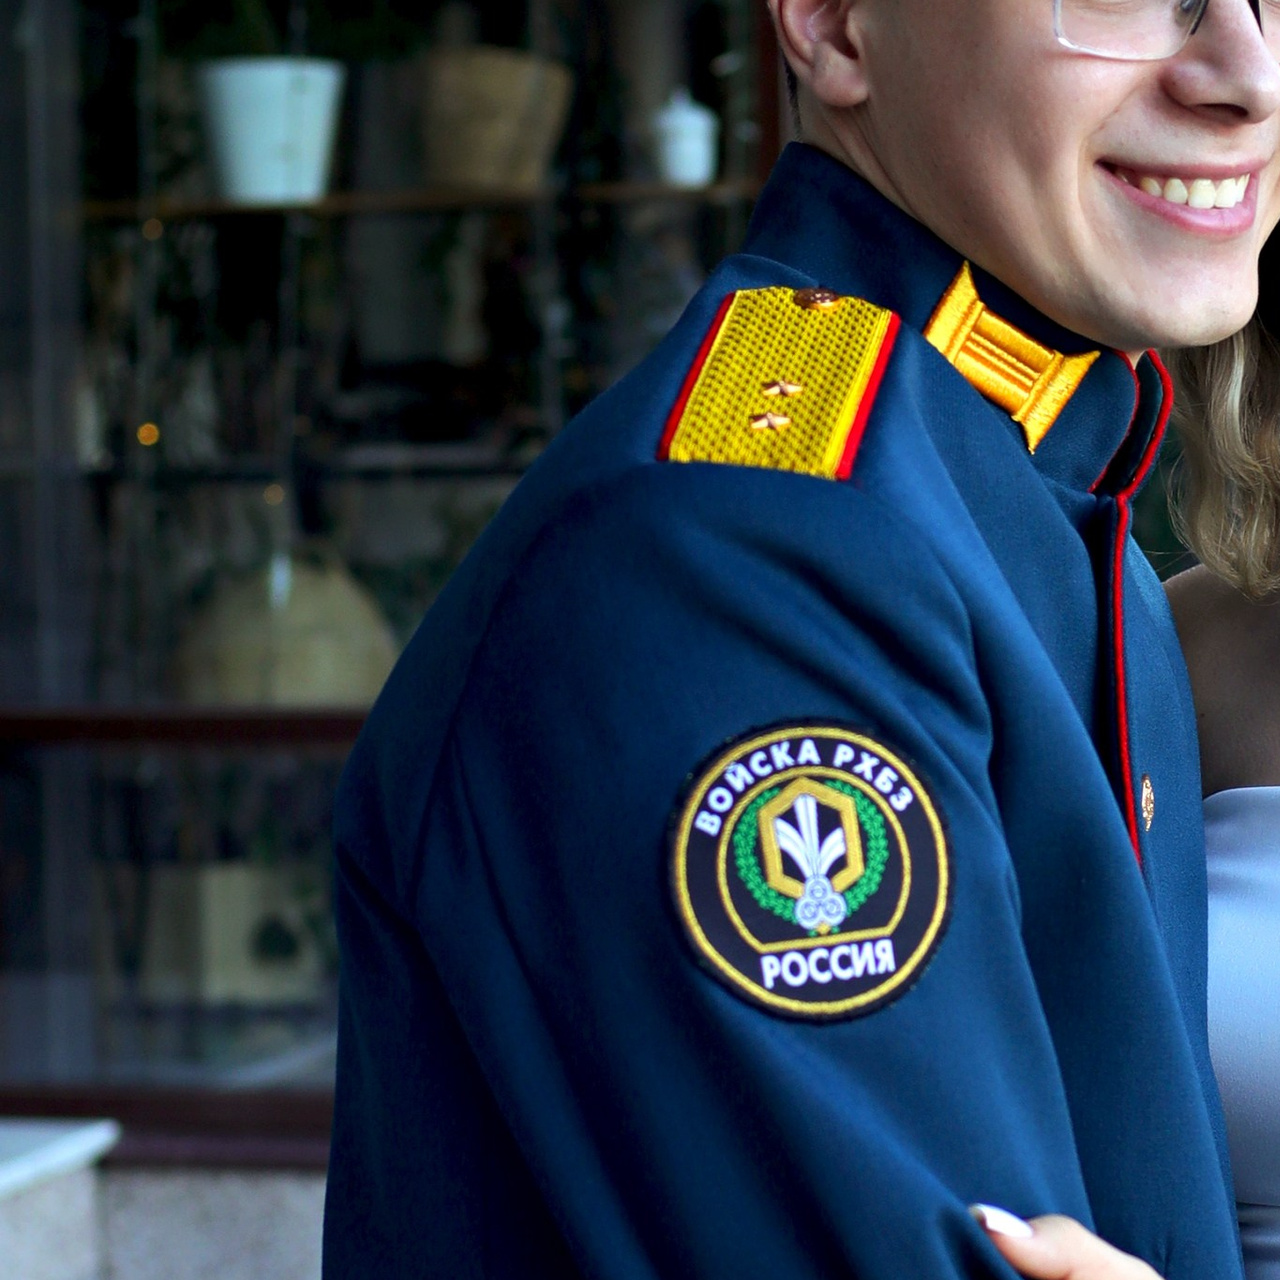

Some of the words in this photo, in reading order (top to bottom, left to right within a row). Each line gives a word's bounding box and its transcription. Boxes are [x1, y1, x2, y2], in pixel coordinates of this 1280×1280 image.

[694, 738, 821, 836] ВОЙСКА
[833, 743, 914, 812] РХБЗ
[760, 939, 896, 989] РОССИЯ
